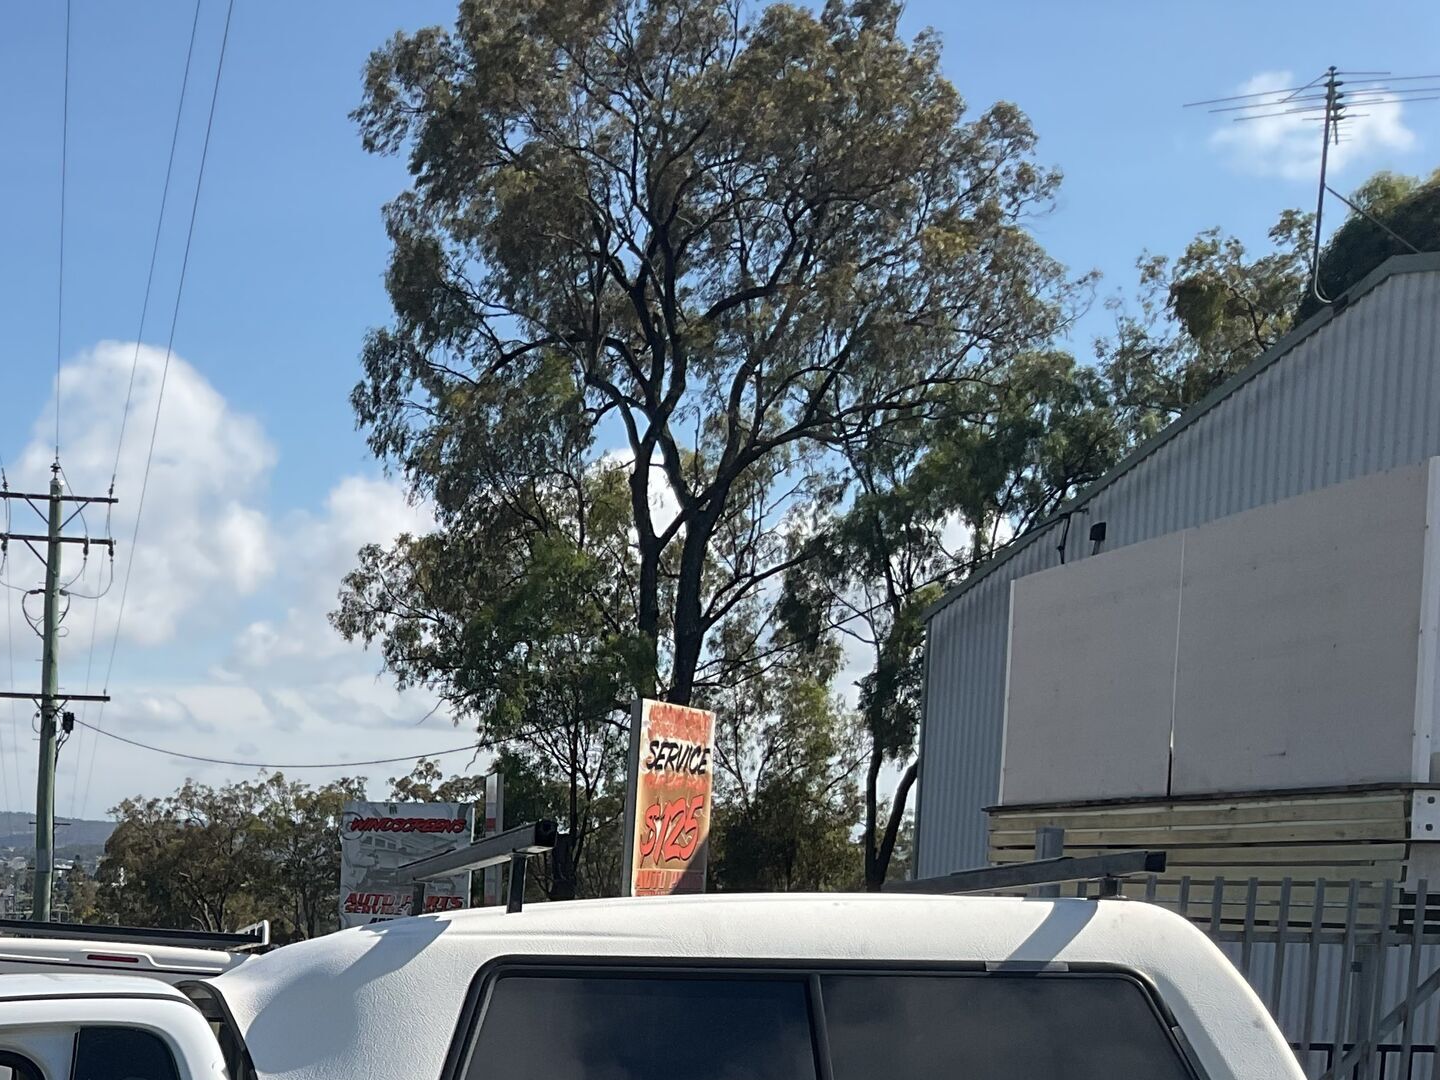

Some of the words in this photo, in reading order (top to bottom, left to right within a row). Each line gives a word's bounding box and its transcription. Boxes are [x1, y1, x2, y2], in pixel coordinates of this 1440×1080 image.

[645, 740, 711, 776] SERVICE
[350, 816, 467, 834] WINDSCREENS
[639, 793, 704, 866] $125
[344, 892, 394, 906] AUTO
[399, 894, 465, 910] PRTS
